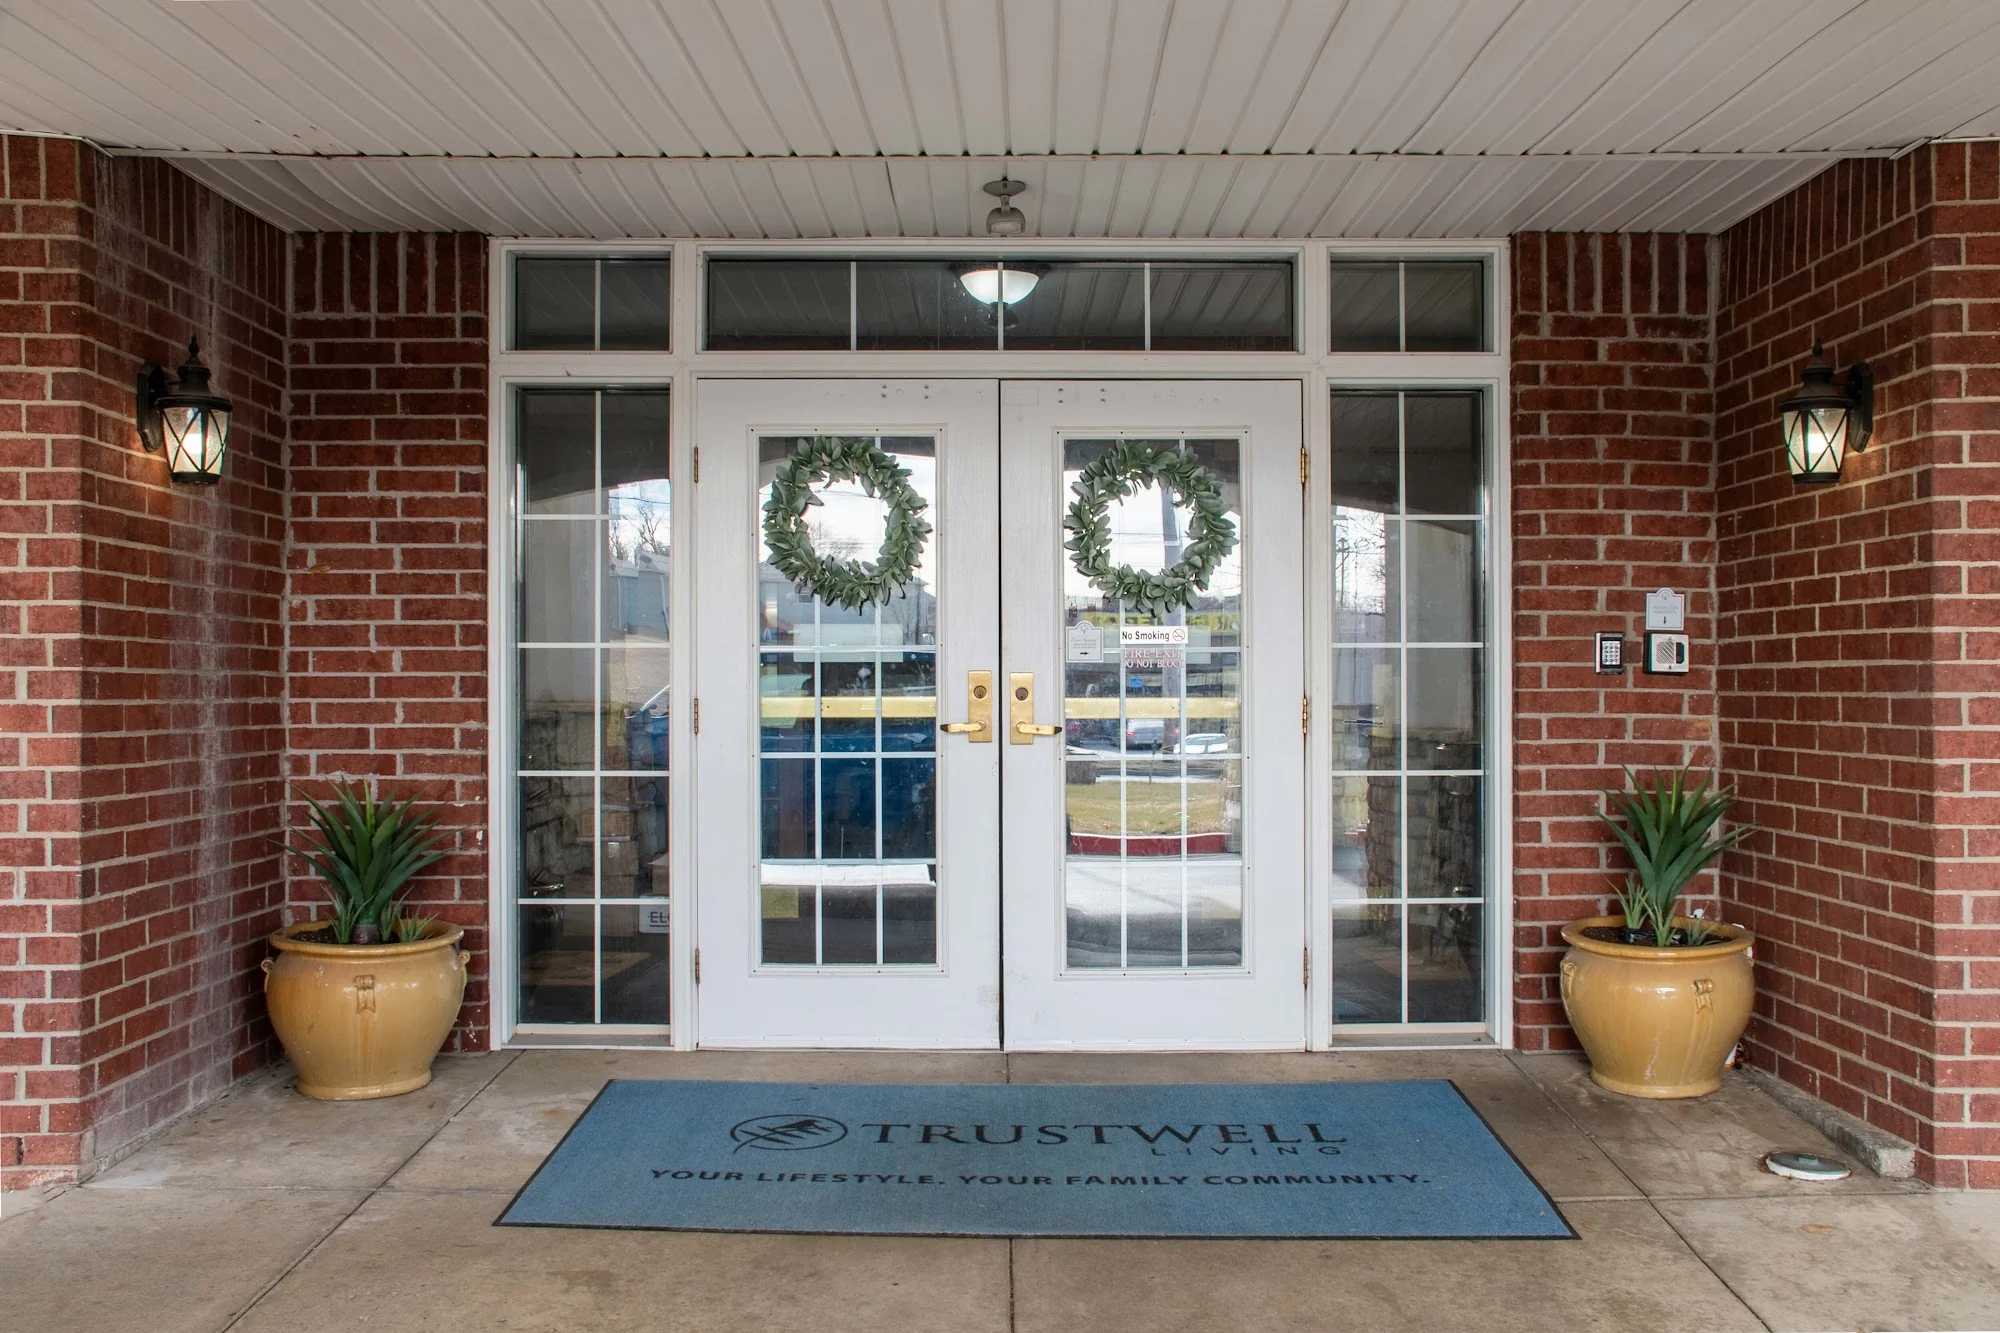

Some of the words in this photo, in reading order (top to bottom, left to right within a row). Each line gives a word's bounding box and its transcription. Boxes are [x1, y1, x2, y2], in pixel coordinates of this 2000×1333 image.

[1121, 630, 1133, 640] No
[1135, 630, 1170, 642] Smoking
[1124, 649, 1150, 658] FIRE
[1155, 649, 1182, 658] EXIT
[1136, 659, 1154, 668] NOT
[650, 911, 670, 923] EL
[861, 1123, 1347, 1145] TRUSTWELL
[1151, 1146, 1341, 1156] LIVING
[651, 1169, 744, 1181] YOUR
[757, 1172, 946, 1184] LIFESTYLE.
[958, 1175, 1053, 1185] YOUR
[1066, 1175, 1189, 1185] FAMILY
[1203, 1174, 1431, 1185] COMMUNITY.
